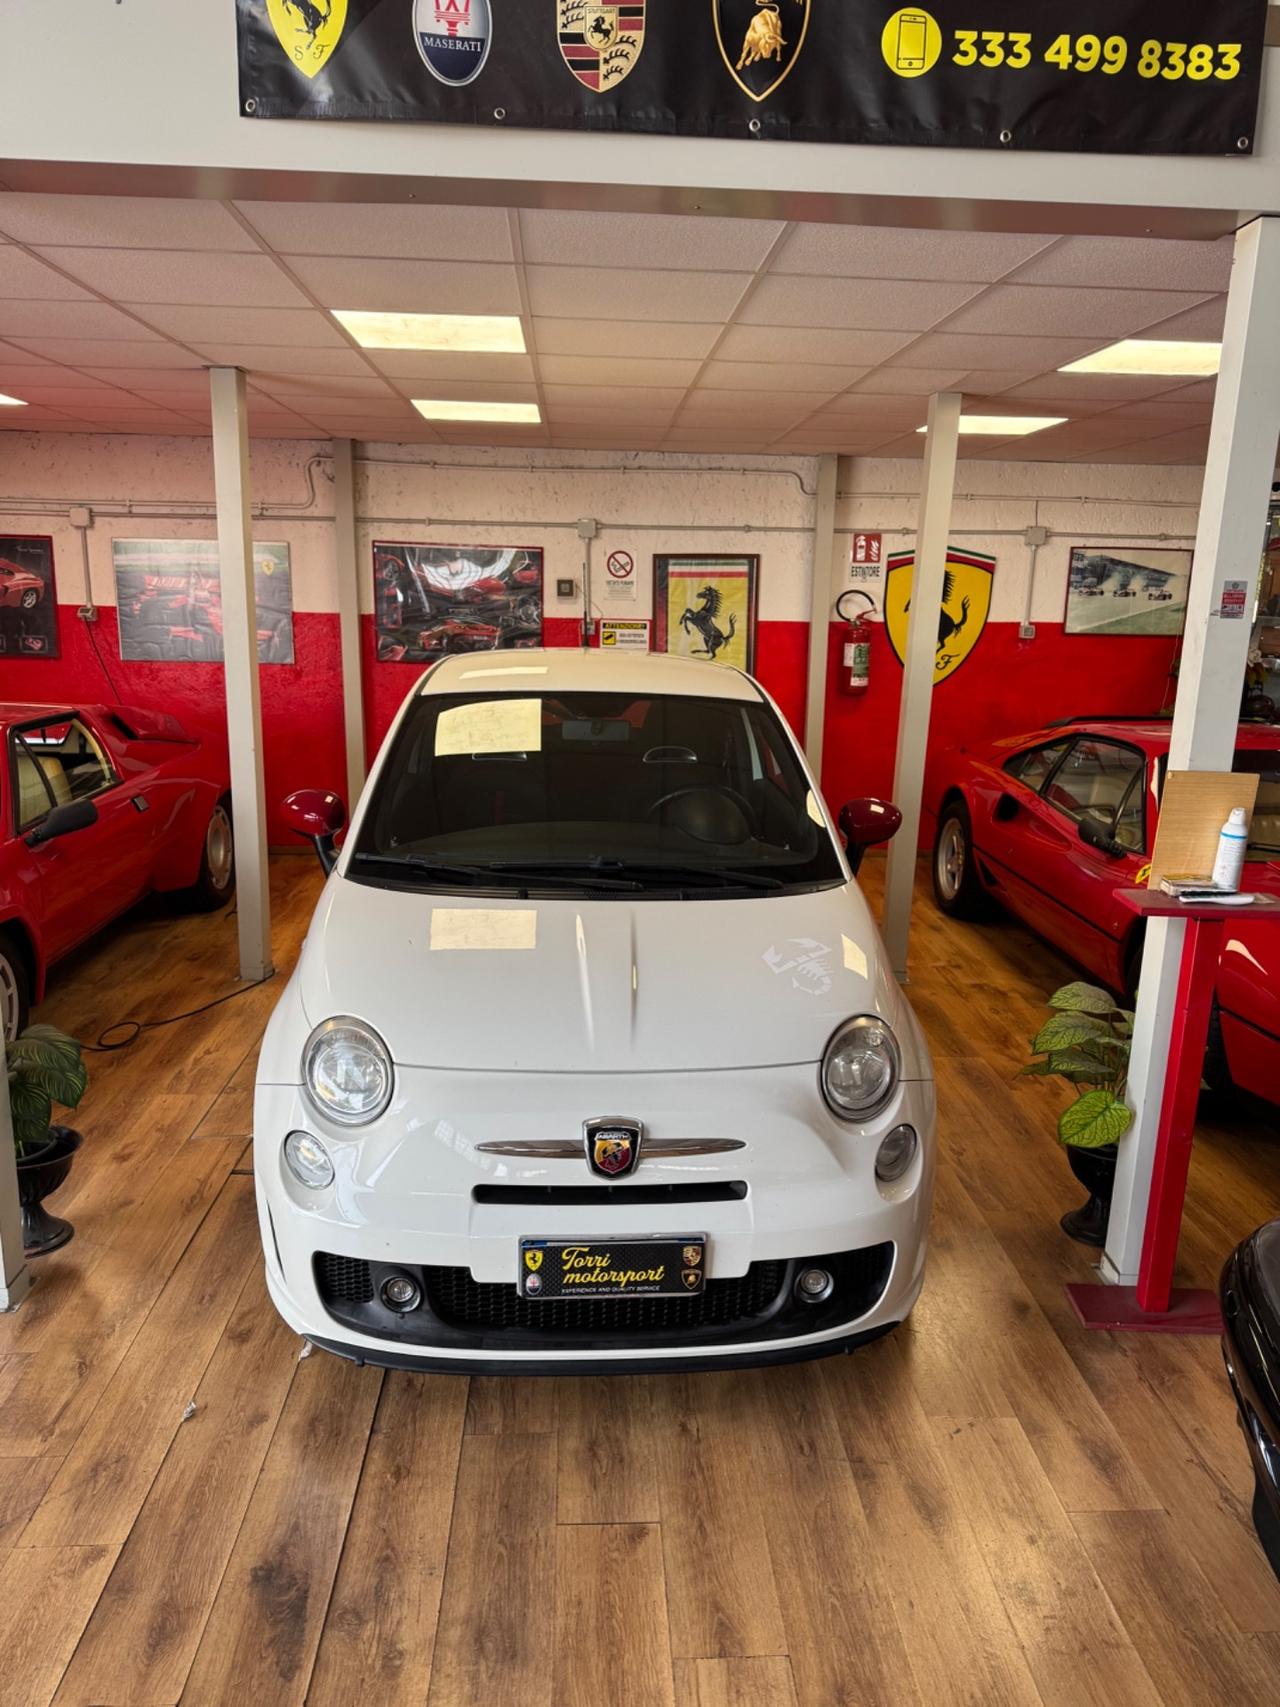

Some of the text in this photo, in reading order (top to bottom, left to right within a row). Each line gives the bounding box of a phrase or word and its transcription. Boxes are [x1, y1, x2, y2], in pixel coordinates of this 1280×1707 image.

[423, 37, 481, 52] MASERATI
[952, 30, 1242, 81] 333 499 8383
[851, 566, 880, 578] ESTINTORE
[561, 1247, 611, 1270] Torri
[562, 1265, 664, 1287] motorsport
